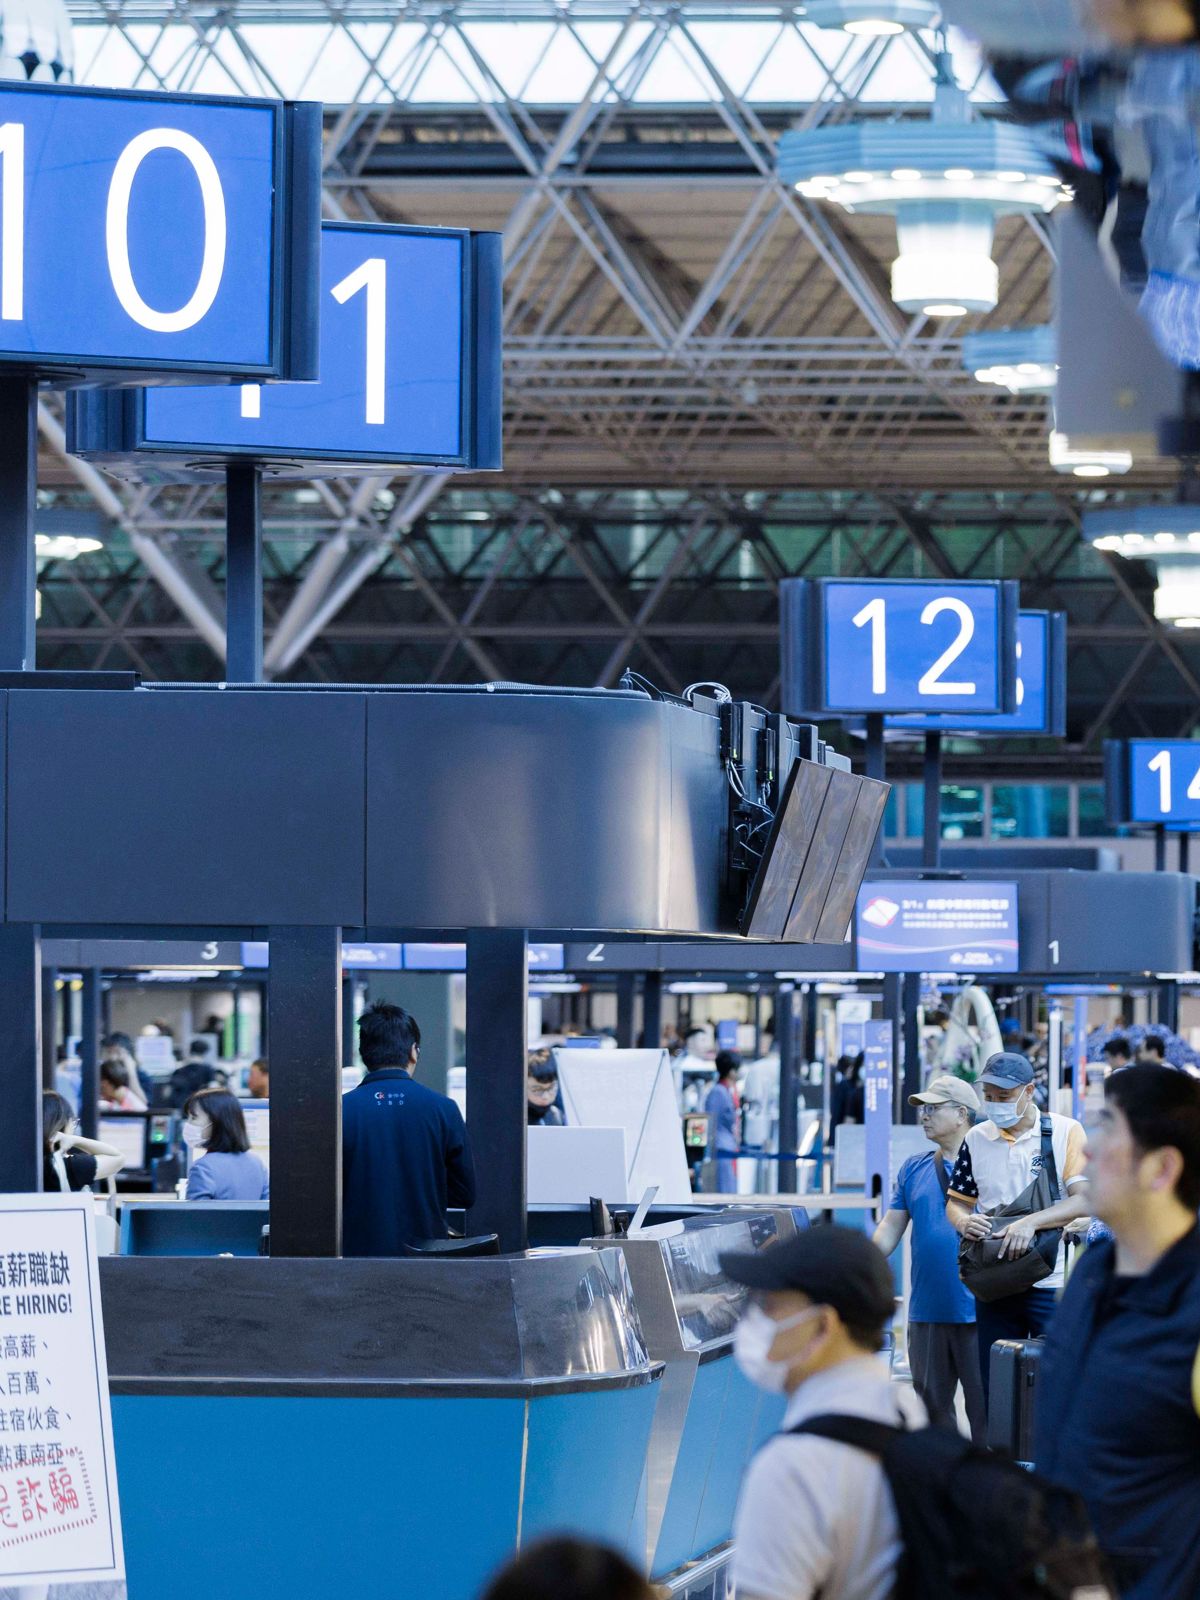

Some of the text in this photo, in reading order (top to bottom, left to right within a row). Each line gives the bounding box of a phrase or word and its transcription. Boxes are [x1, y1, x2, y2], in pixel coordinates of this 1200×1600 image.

[0, 123, 226, 333] 10
[852, 597, 976, 695] 12
[1048, 940, 1060, 965] 1
[0, 1251, 71, 1288] 薪職缺
[16, 1294, 73, 1315] HIRING!
[0, 1333, 49, 1360] 高薪、
